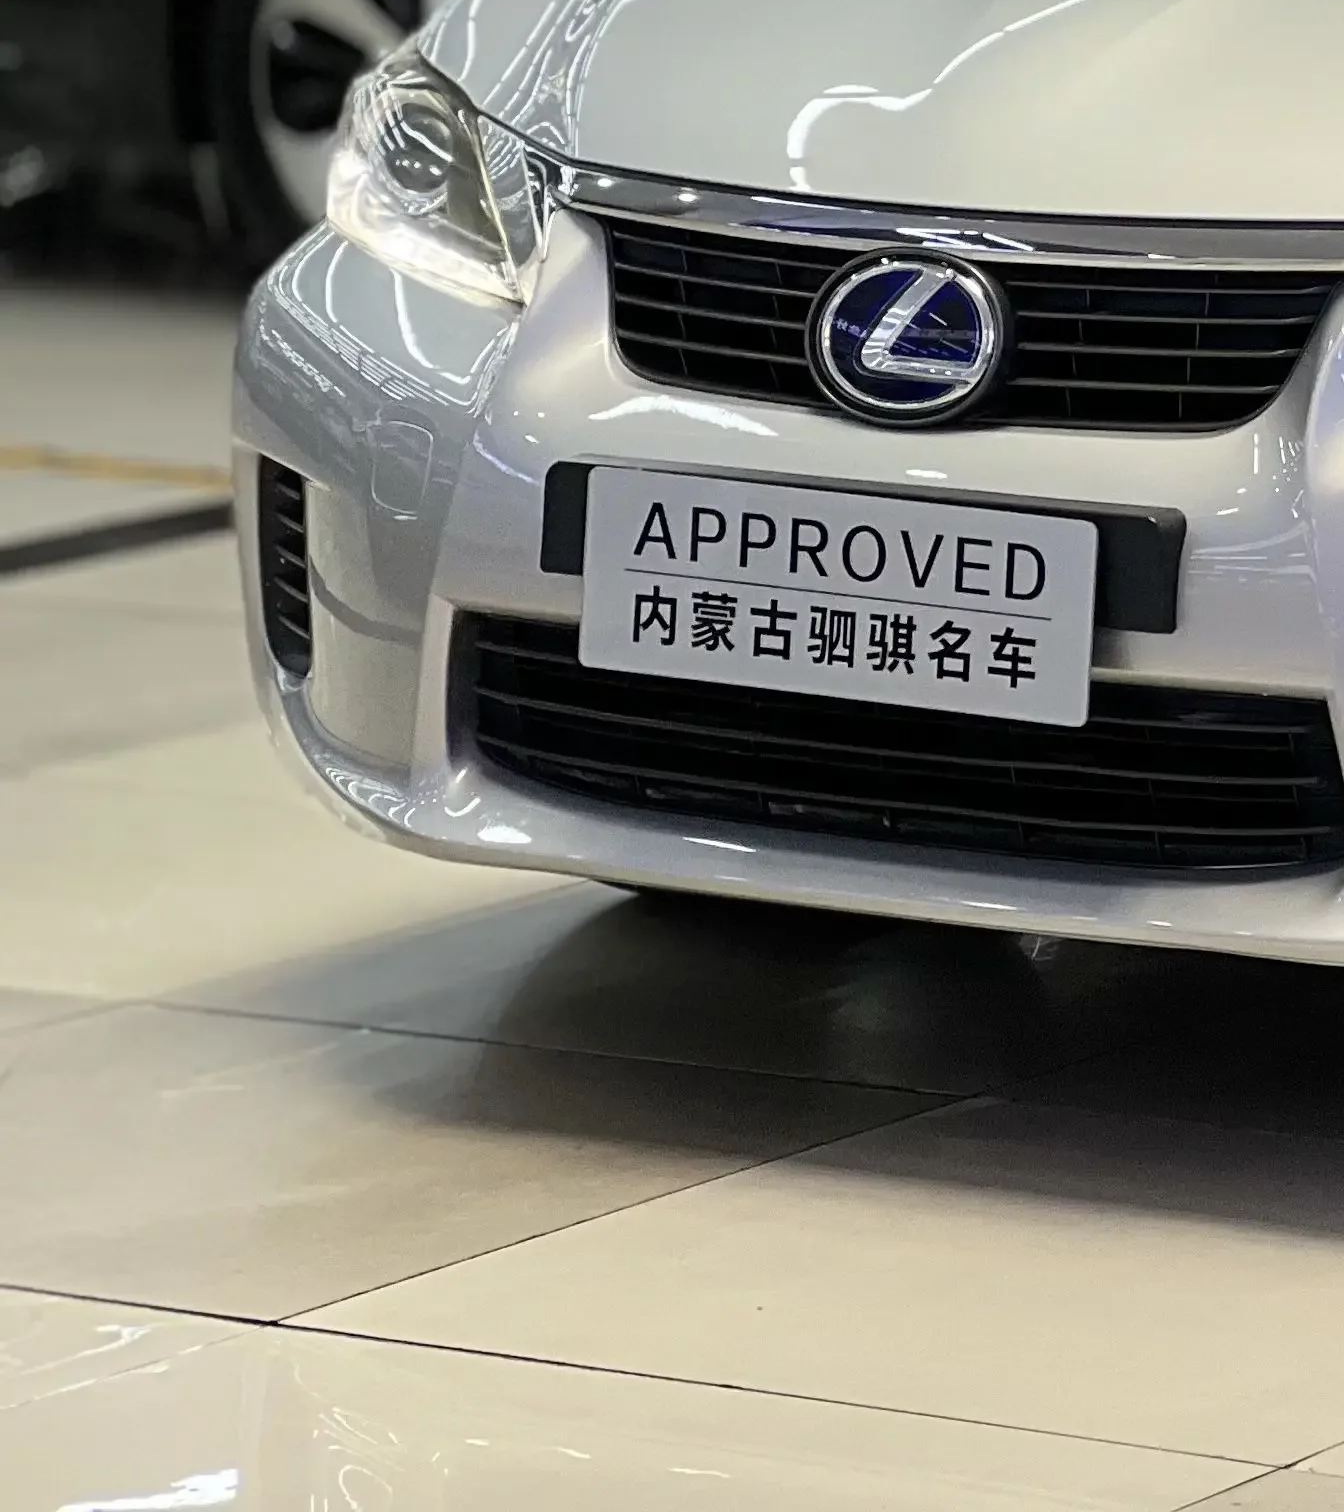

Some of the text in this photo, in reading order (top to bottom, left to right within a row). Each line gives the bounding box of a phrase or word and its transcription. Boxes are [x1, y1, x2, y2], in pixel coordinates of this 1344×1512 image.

[633, 501, 1047, 602] APPROVED
[632, 585, 1038, 689] 内蒙古驷骐名车
